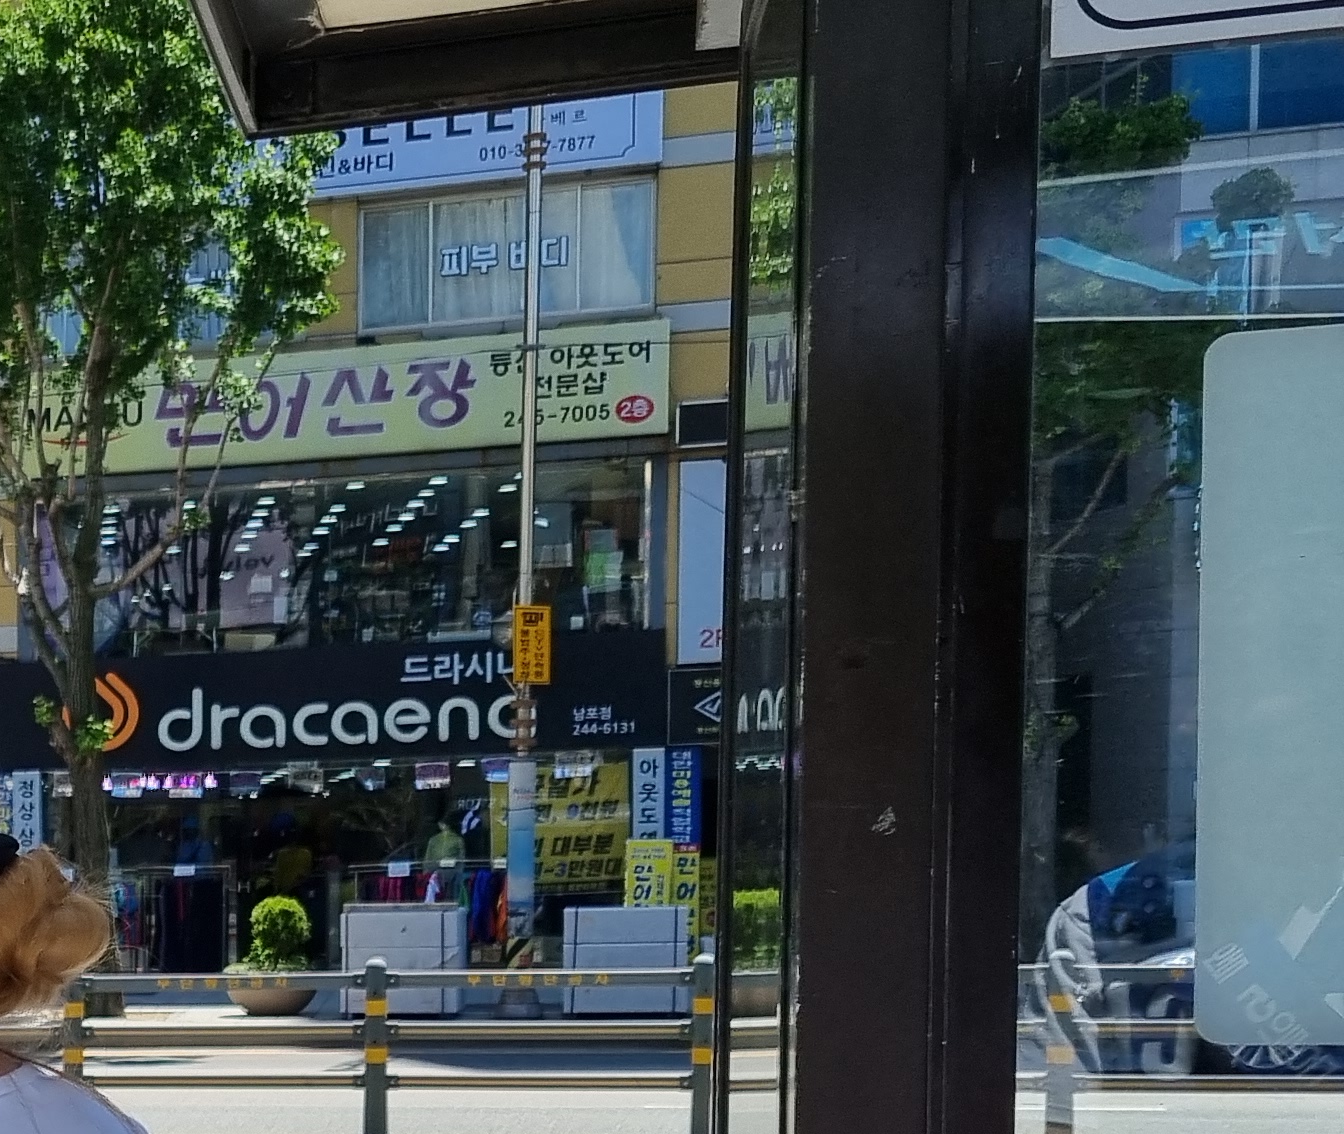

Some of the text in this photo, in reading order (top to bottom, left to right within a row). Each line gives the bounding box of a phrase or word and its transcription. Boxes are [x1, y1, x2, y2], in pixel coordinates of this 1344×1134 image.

[550, 108, 587, 126] 베르
[479, 136, 596, 163] 010-37-7877
[440, 242, 499, 277] 피부
[550, 340, 651, 370] 아웃도어
[504, 400, 650, 428] 25-7005 2층
[157, 686, 538, 752] dracaena
[573, 705, 612, 722] 남포점
[572, 721, 636, 736] 244-6131
[633, 864, 653, 907] 만어
